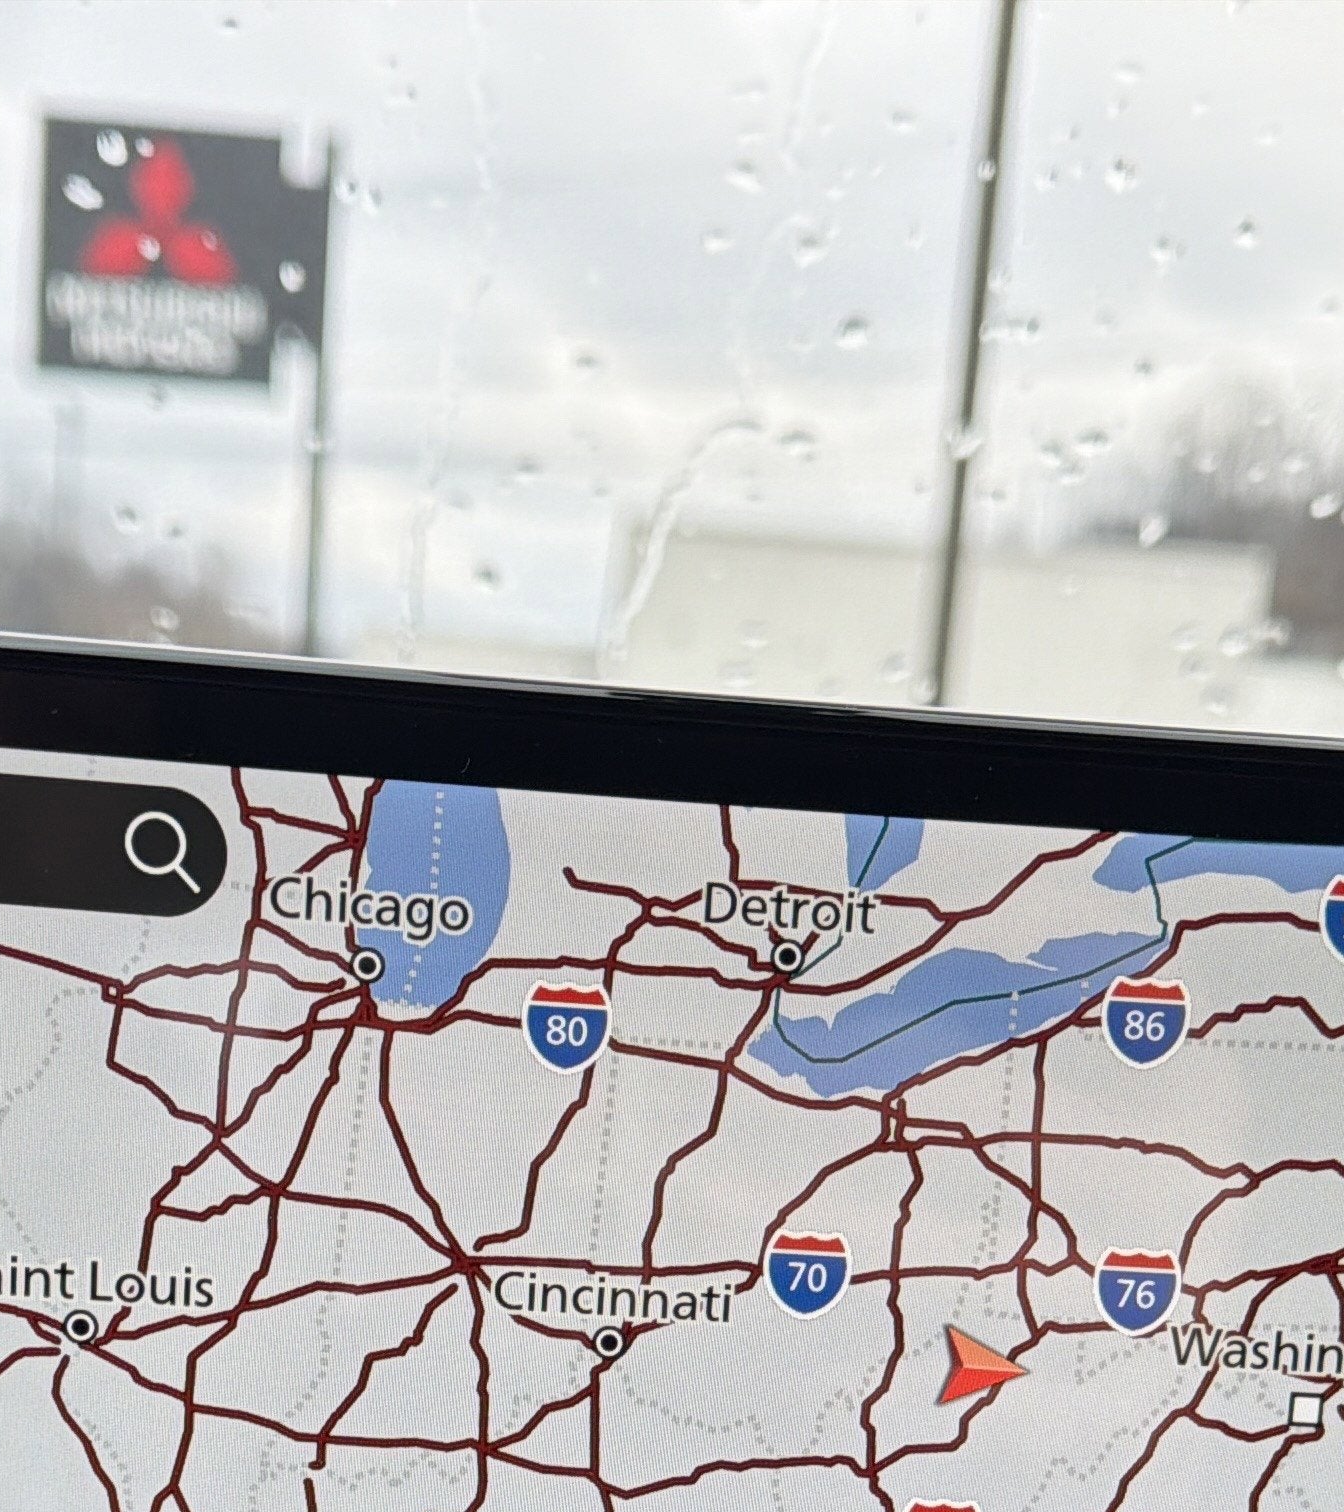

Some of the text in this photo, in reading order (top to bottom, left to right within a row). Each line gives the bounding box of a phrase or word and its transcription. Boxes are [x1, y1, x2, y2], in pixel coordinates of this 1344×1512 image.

[269, 876, 470, 940] Chicago
[703, 880, 877, 934] Detroit
[546, 1015, 588, 1048] 80
[1124, 1009, 1166, 1042] 86
[89, 1260, 214, 1308] Louis
[493, 1271, 733, 1323] Cincinnati
[787, 1261, 828, 1293] 70
[1116, 1278, 1157, 1310] 76
